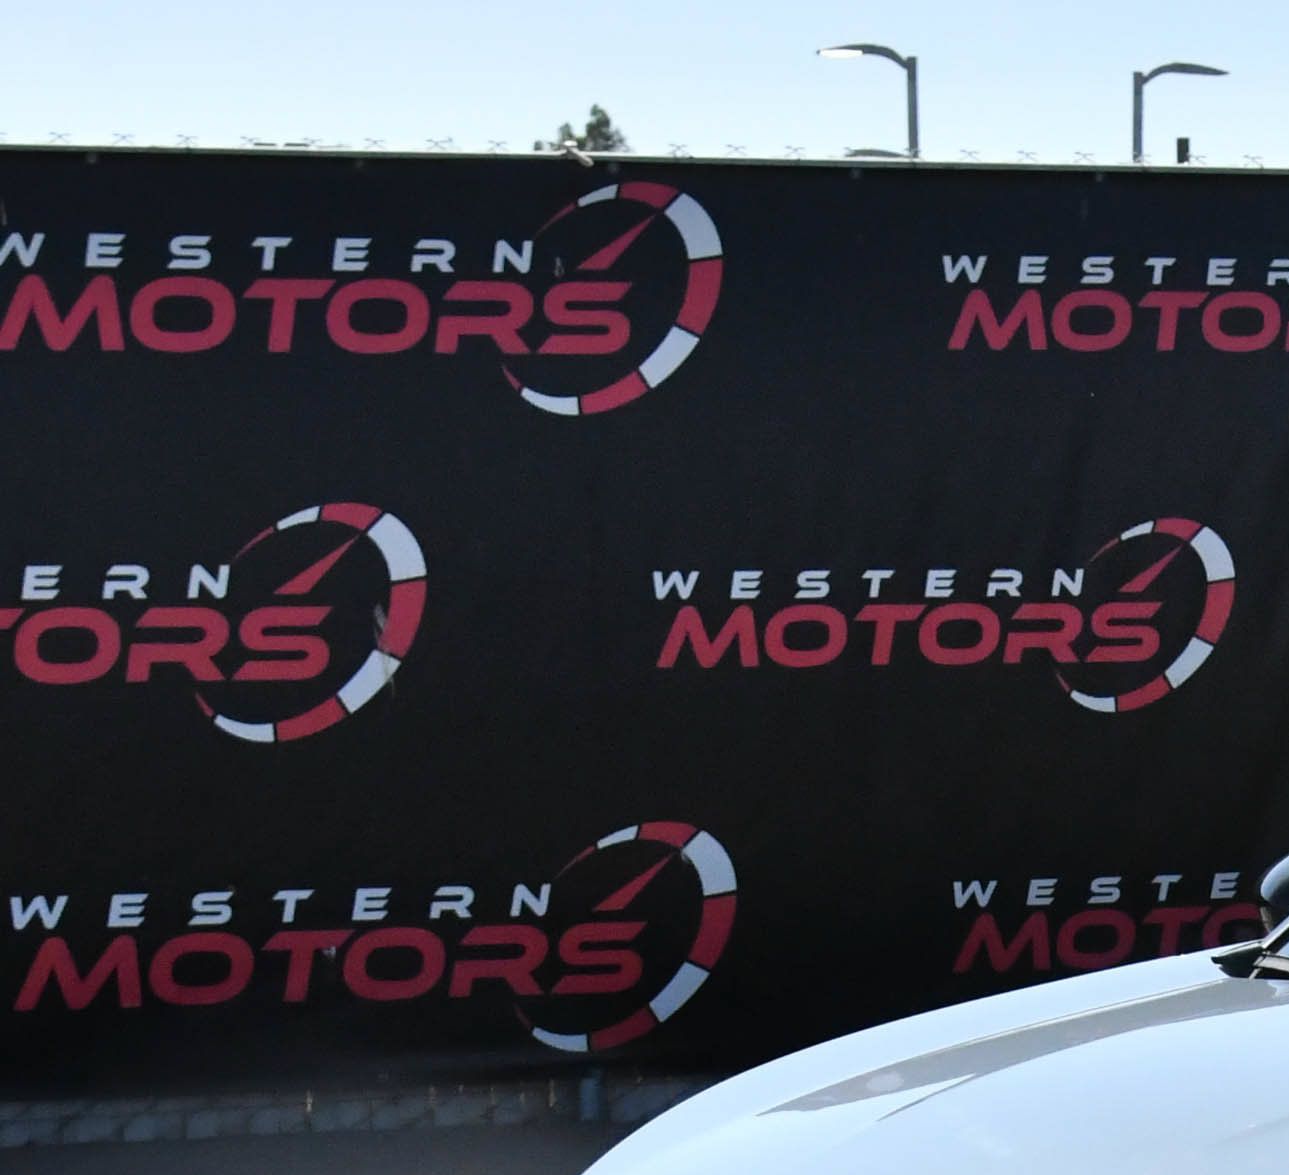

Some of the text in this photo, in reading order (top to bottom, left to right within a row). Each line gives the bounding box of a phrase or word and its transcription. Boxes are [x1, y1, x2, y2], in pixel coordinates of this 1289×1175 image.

[0, 232, 535, 273] WESTERN
[0, 273, 633, 355] MOTORS
[21, 565, 231, 599] ERN
[652, 569, 1085, 601] WESTERN
[656, 602, 1163, 668] MOTORS
[10, 883, 552, 931] WESTERN
[953, 871, 1240, 907] WESTE
[17, 920, 648, 1011] MOTORS
